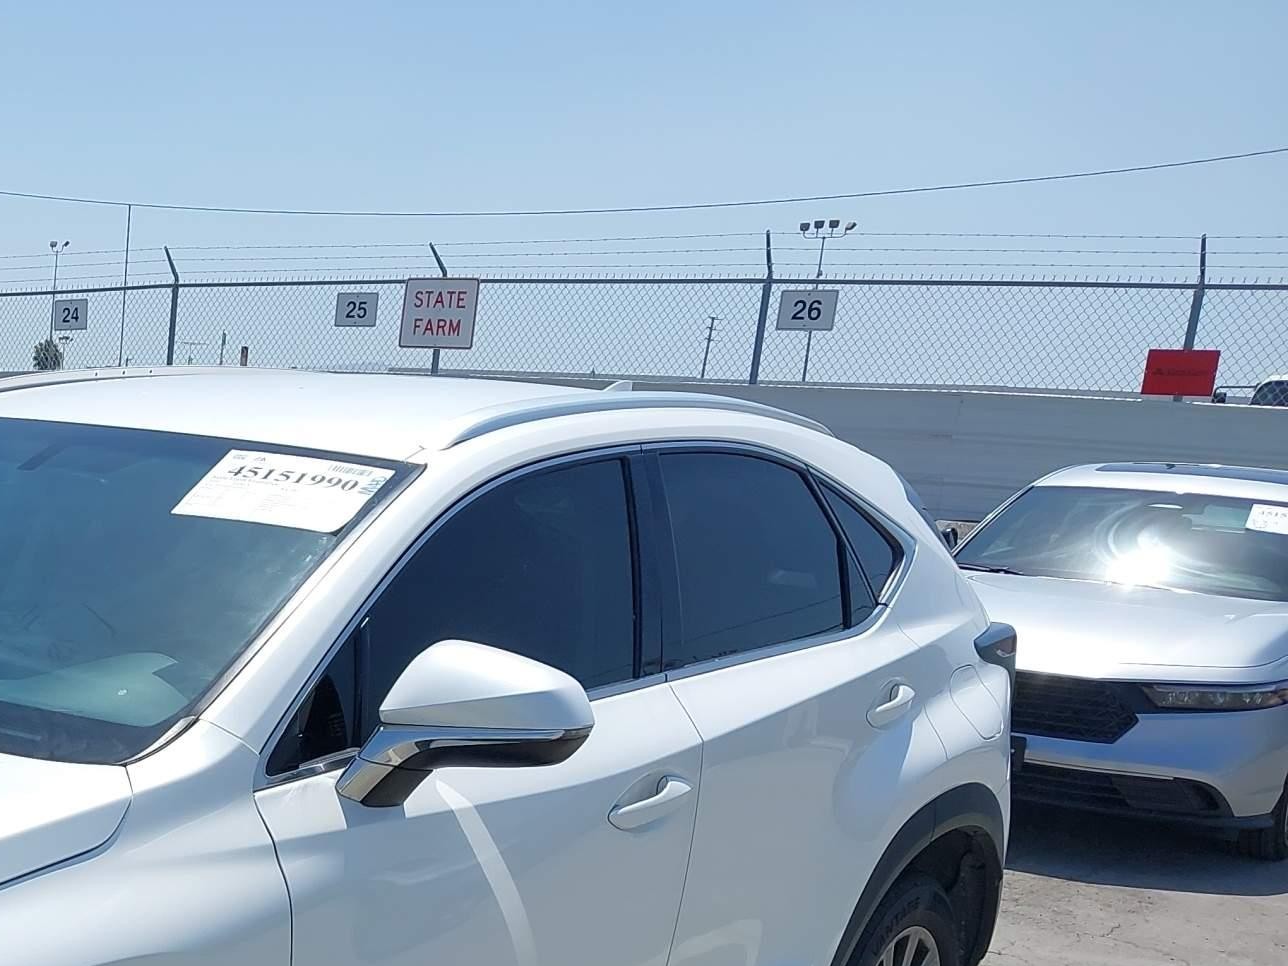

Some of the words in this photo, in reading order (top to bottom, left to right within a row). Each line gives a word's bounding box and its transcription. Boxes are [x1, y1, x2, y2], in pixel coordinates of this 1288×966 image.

[414, 291, 467, 309] STATE
[62, 307, 80, 323] 24
[345, 301, 367, 319] 25
[791, 300, 822, 322] 26
[413, 319, 461, 337] FARM
[228, 465, 359, 491] 45151990
